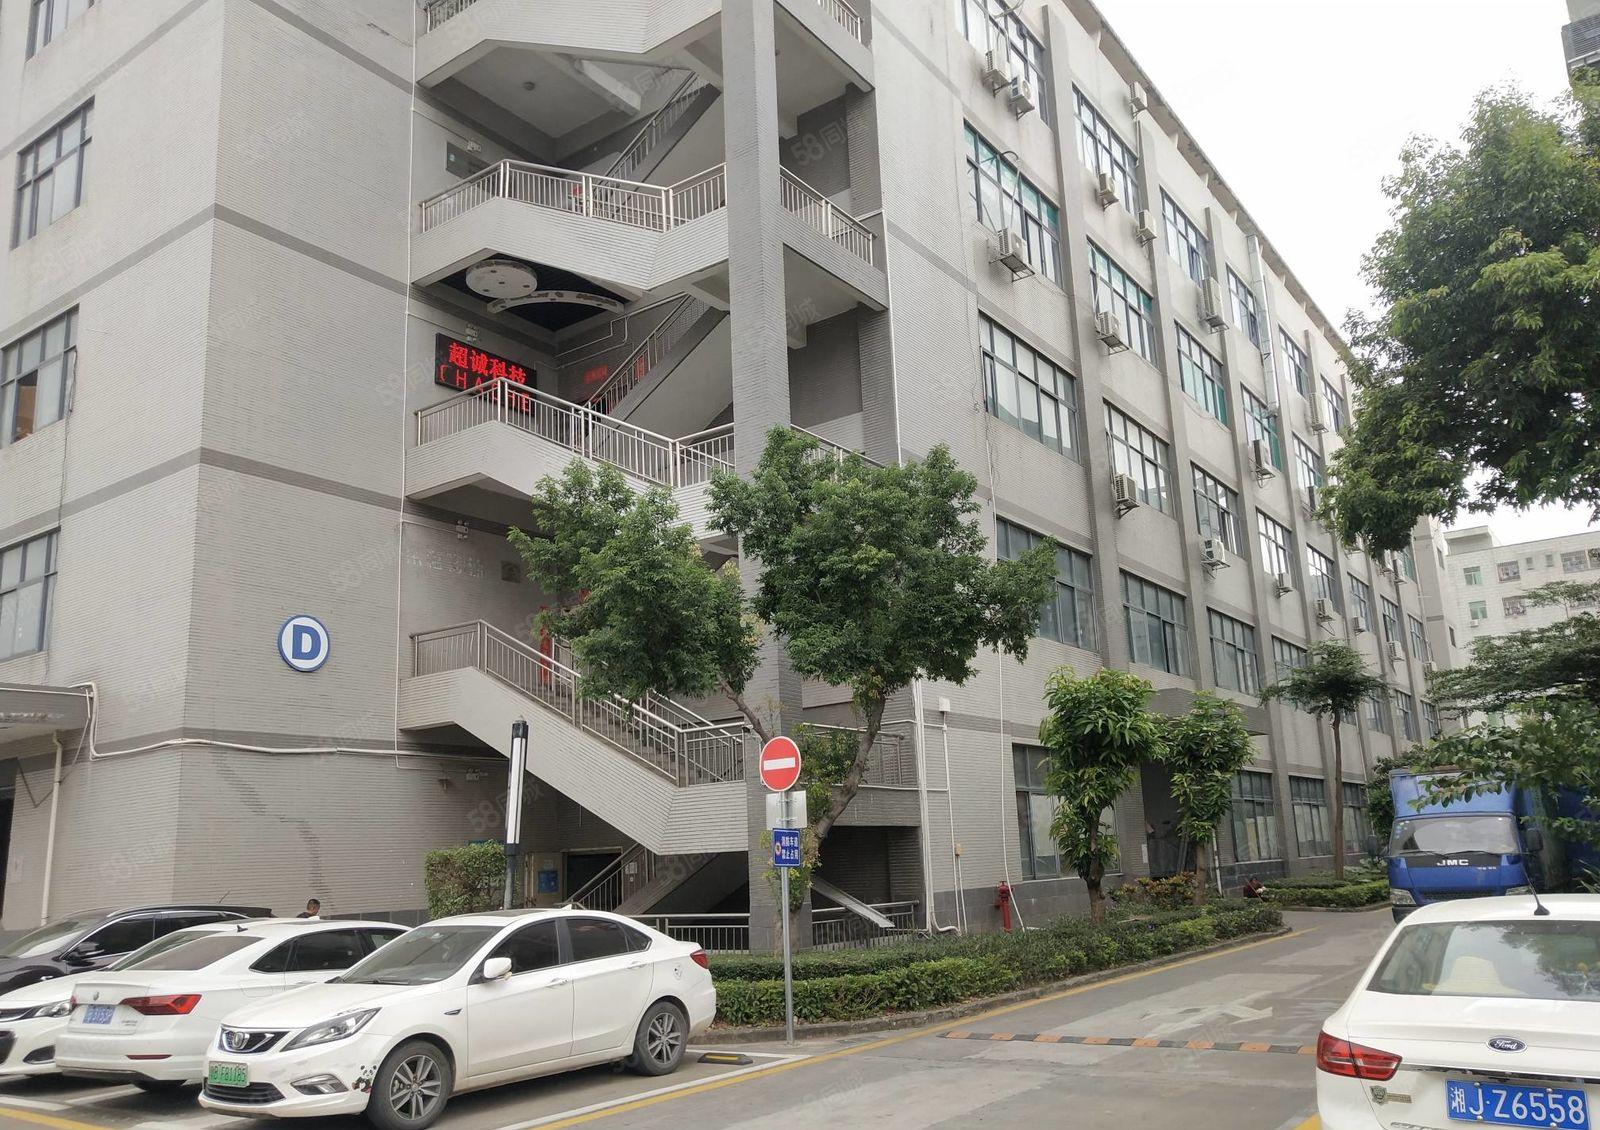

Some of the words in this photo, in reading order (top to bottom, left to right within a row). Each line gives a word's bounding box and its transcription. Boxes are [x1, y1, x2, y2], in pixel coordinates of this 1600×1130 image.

[449, 342, 527, 386] 超诚科技
[291, 624, 322, 661] D
[1492, 1038, 1520, 1051] Ford
